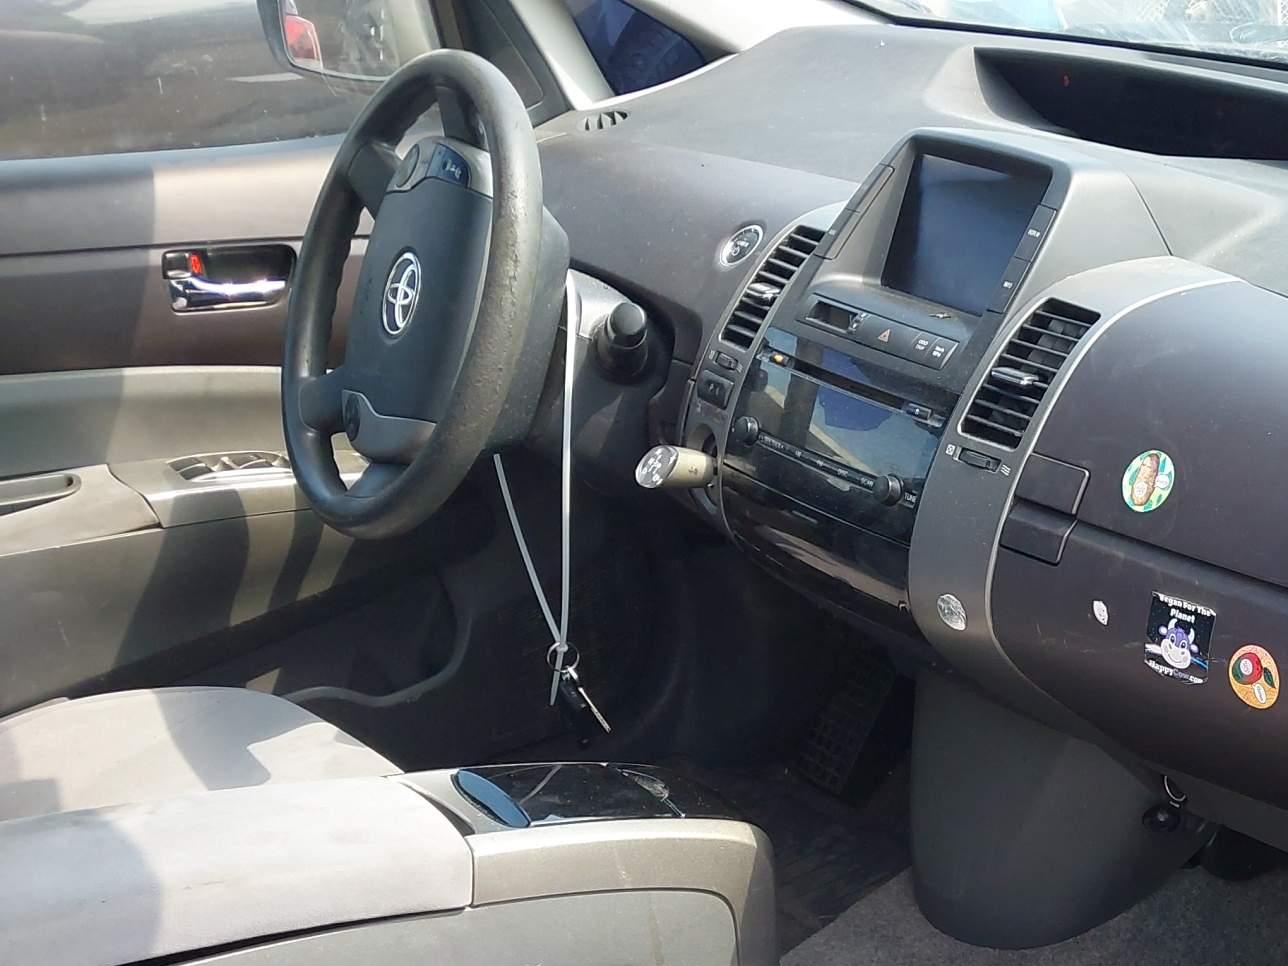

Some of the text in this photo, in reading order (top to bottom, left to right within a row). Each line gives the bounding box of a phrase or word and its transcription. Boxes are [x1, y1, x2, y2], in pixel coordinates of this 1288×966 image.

[1170, 608, 1195, 624] Planet
[1183, 601, 1196, 612] For
[1197, 605, 1211, 617] The
